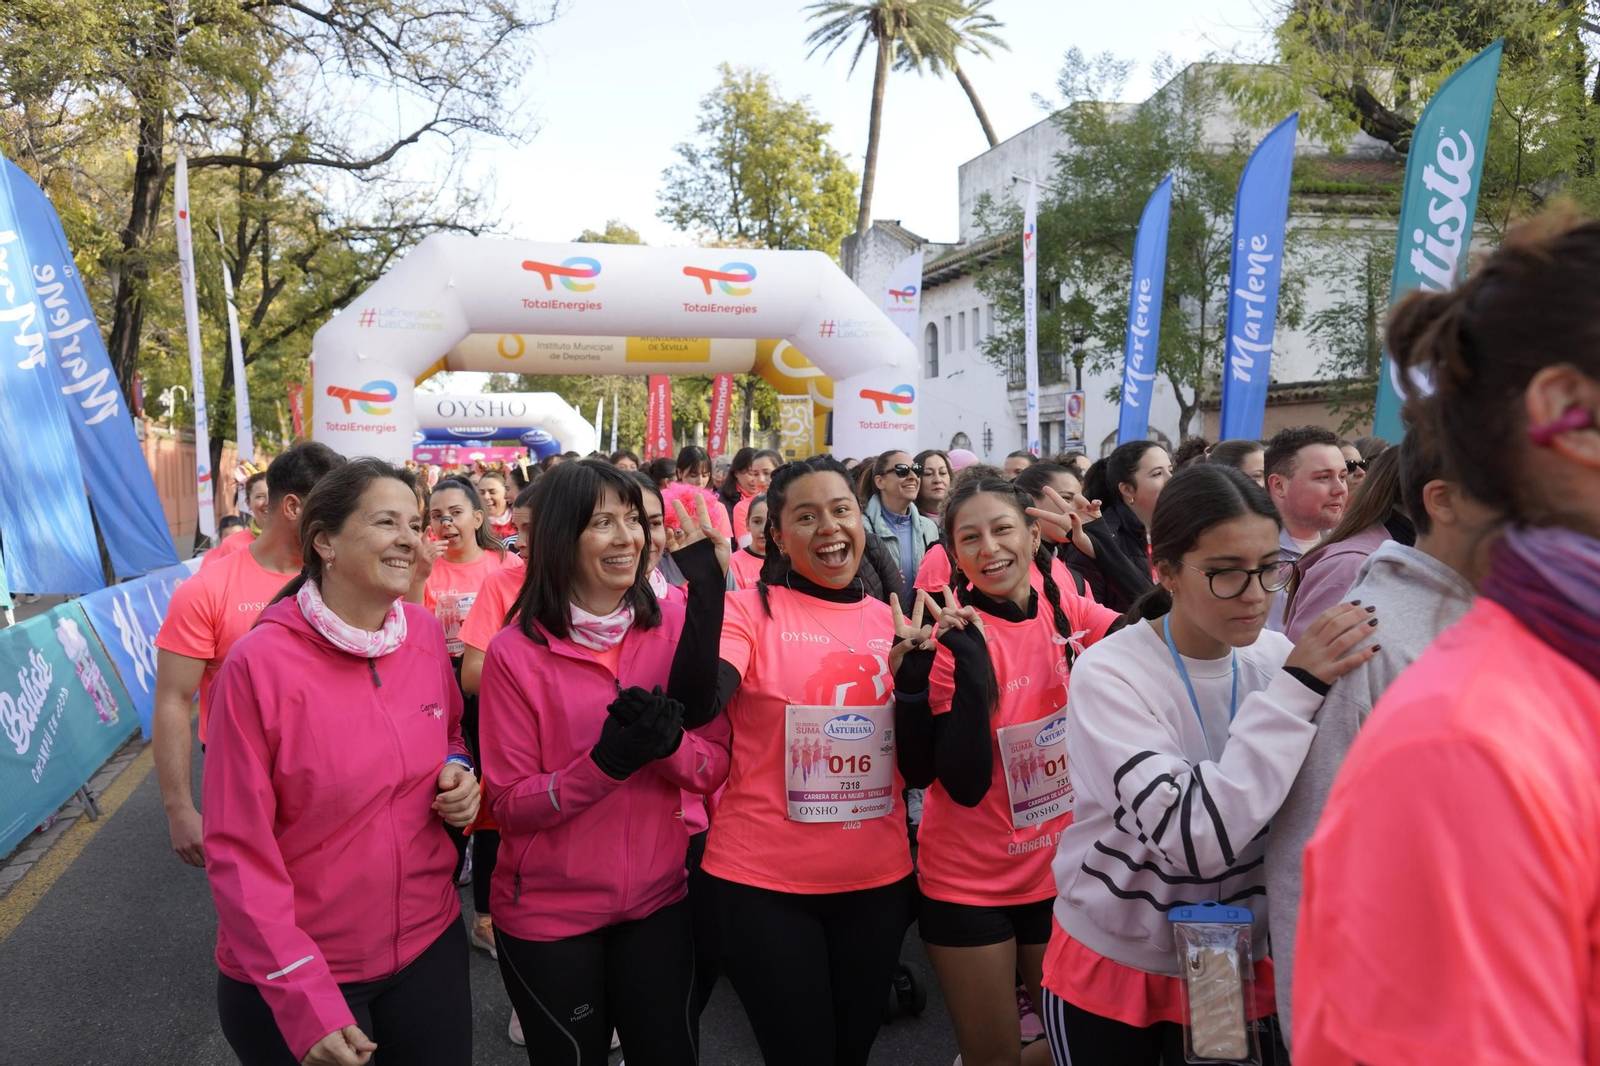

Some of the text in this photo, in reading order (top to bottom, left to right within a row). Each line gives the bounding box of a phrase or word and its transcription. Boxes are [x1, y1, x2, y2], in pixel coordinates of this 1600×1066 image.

[522, 299, 602, 312] TotalEnergies
[683, 302, 758, 315] TotalEnergies
[1231, 234, 1274, 382] Marlene
[537, 341, 614, 352] Instituto Municipal
[648, 343, 689, 351] DE SEVILLA
[1124, 278, 1155, 408] Marlene
[549, 352, 601, 362] de Deportes
[437, 400, 527, 418] OYSHO
[713, 375, 728, 435] Santander
[326, 421, 397, 434] TotalEnergies
[859, 420, 916, 431] TotalEnergies
[238, 602, 269, 612] OYSH
[781, 631, 830, 644] OYSHO
[828, 723, 872, 734] ASTURIANA
[1010, 742, 1033, 753] SUMA
[829, 755, 871, 774] 016
[1044, 754, 1067, 777] 01
[840, 781, 860, 790] 7318
[1056, 776, 1069, 788] 731
[803, 792, 830, 800] CARRERA
[1028, 796, 1050, 808] CARRERA
[799, 806, 838, 815] OYSHO
[859, 804, 886, 813] Santander
[1026, 803, 1059, 821] OYSHO
[1008, 834, 1053, 855] CARRERA
